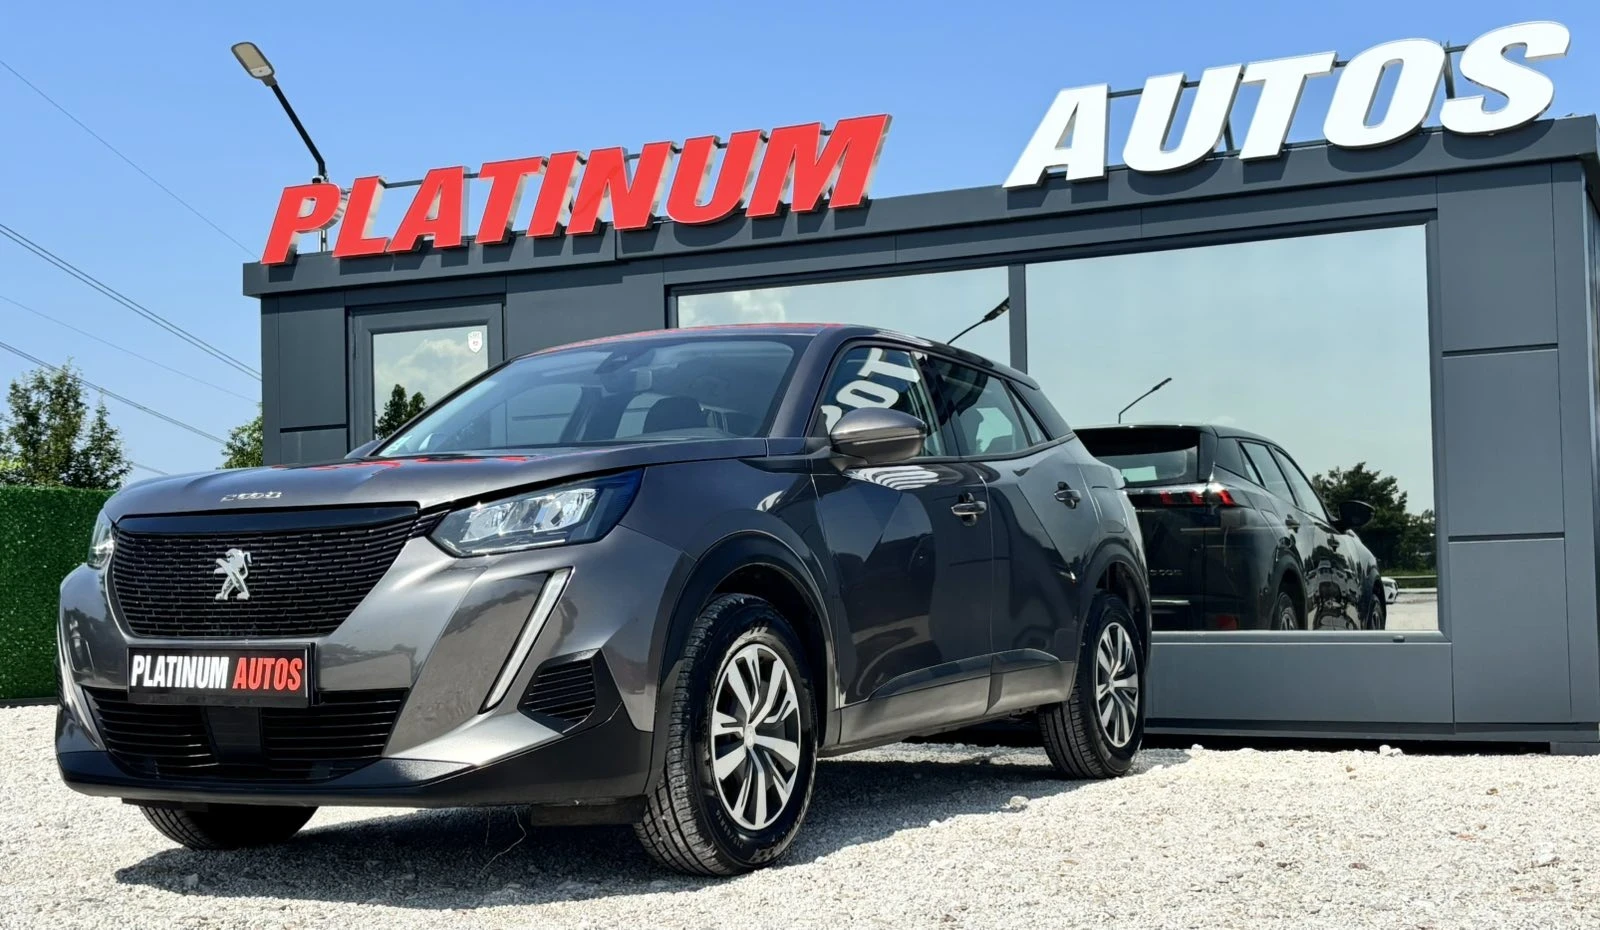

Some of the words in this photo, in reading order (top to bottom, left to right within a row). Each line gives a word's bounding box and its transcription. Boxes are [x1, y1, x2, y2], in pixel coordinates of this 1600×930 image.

[260, 113, 892, 266] PLATINUM
[1003, 20, 1571, 190] AUTOS
[130, 655, 229, 689] PLATINUM
[232, 657, 303, 691] AUTOS
